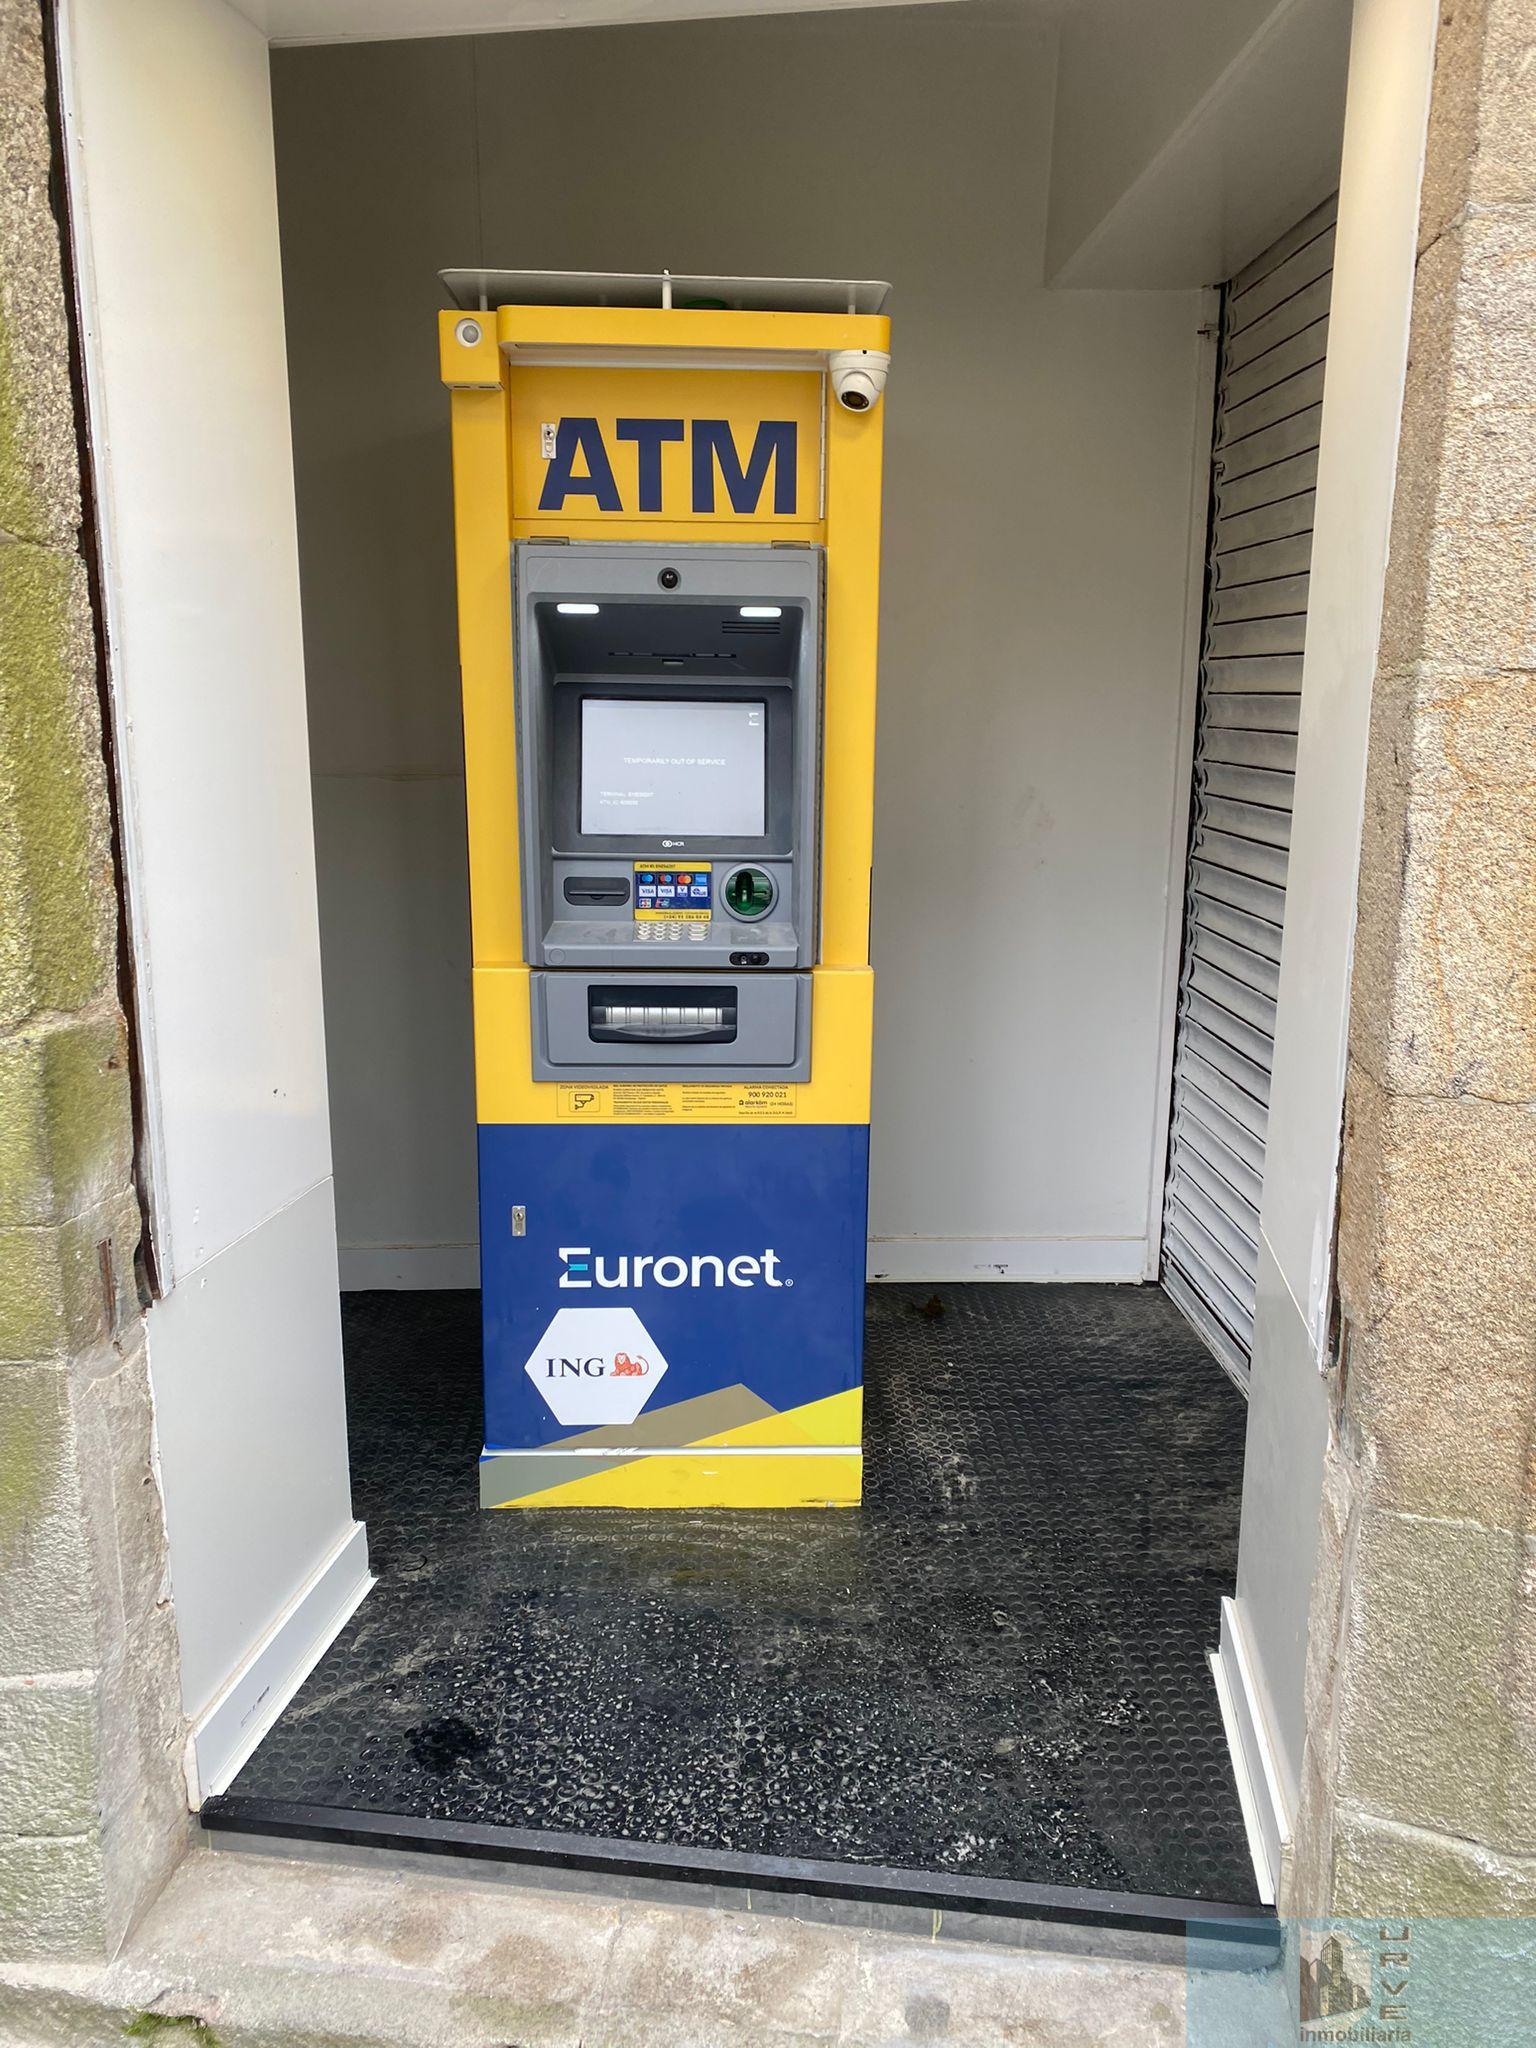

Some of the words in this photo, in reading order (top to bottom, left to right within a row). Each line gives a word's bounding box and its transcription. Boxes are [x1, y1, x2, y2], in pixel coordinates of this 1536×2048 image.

[538, 417, 798, 515] ATM
[623, 757, 669, 765] TEMPORARILY
[670, 757, 685, 765] OUT
[686, 757, 696, 765] OF
[697, 758, 727, 766] SERVICE
[546, 1357, 605, 1378] ING
